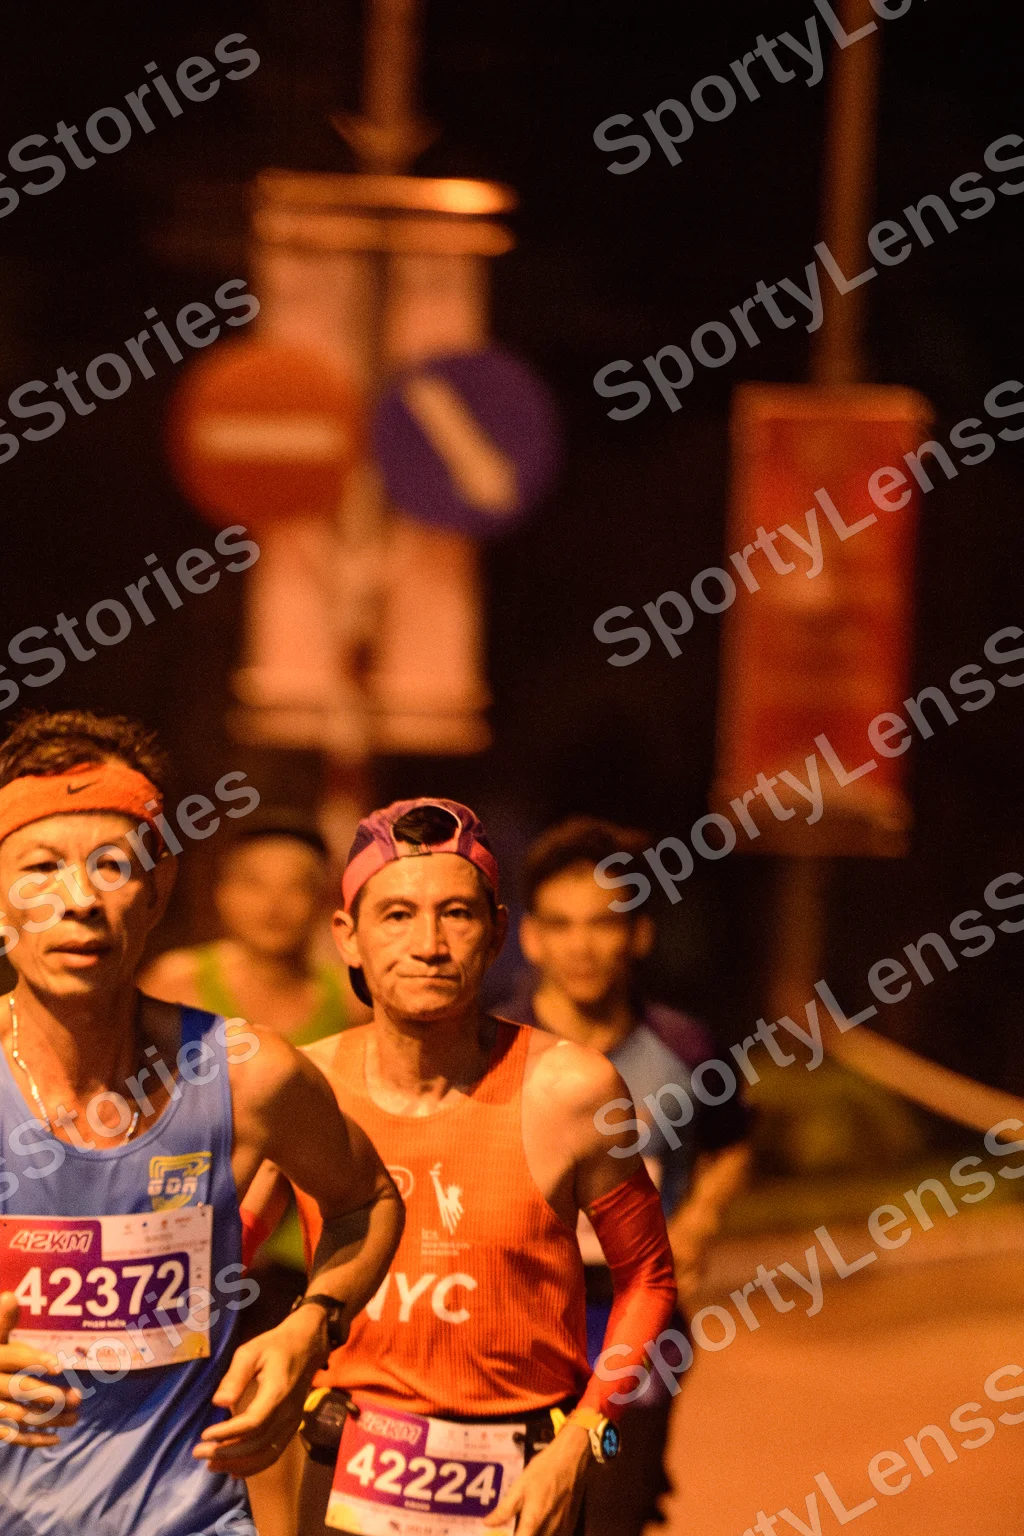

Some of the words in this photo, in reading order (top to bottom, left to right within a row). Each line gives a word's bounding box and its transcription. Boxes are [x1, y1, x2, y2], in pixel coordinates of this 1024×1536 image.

[9, 1229, 94, 1253] 42KM
[13, 1259, 185, 1318] 42372
[346, 1442, 497, 1506] 42224
